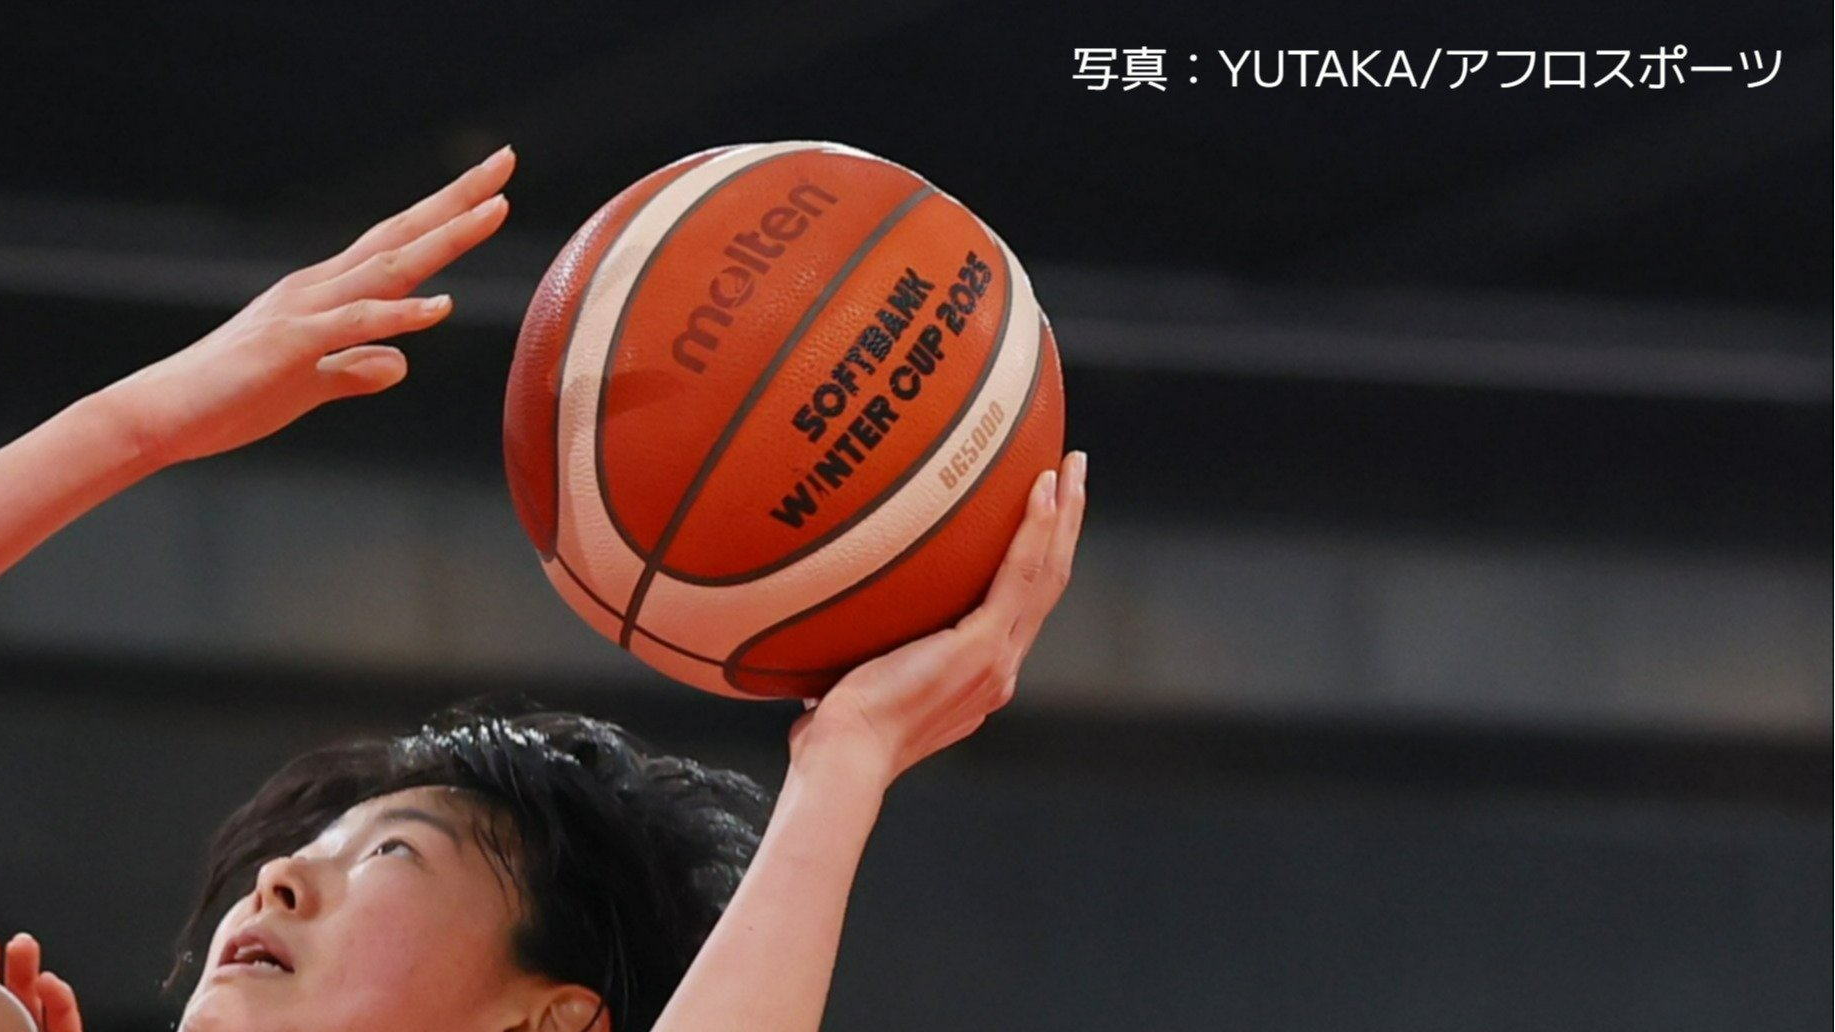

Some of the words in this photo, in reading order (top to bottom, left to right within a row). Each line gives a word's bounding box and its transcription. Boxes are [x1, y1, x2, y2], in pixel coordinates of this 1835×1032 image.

[672, 183, 839, 375] molten
[791, 266, 935, 443] SOFTBANK
[769, 394, 900, 529] WINTER
[888, 323, 945, 401] CUP
[935, 250, 992, 337] 2025
